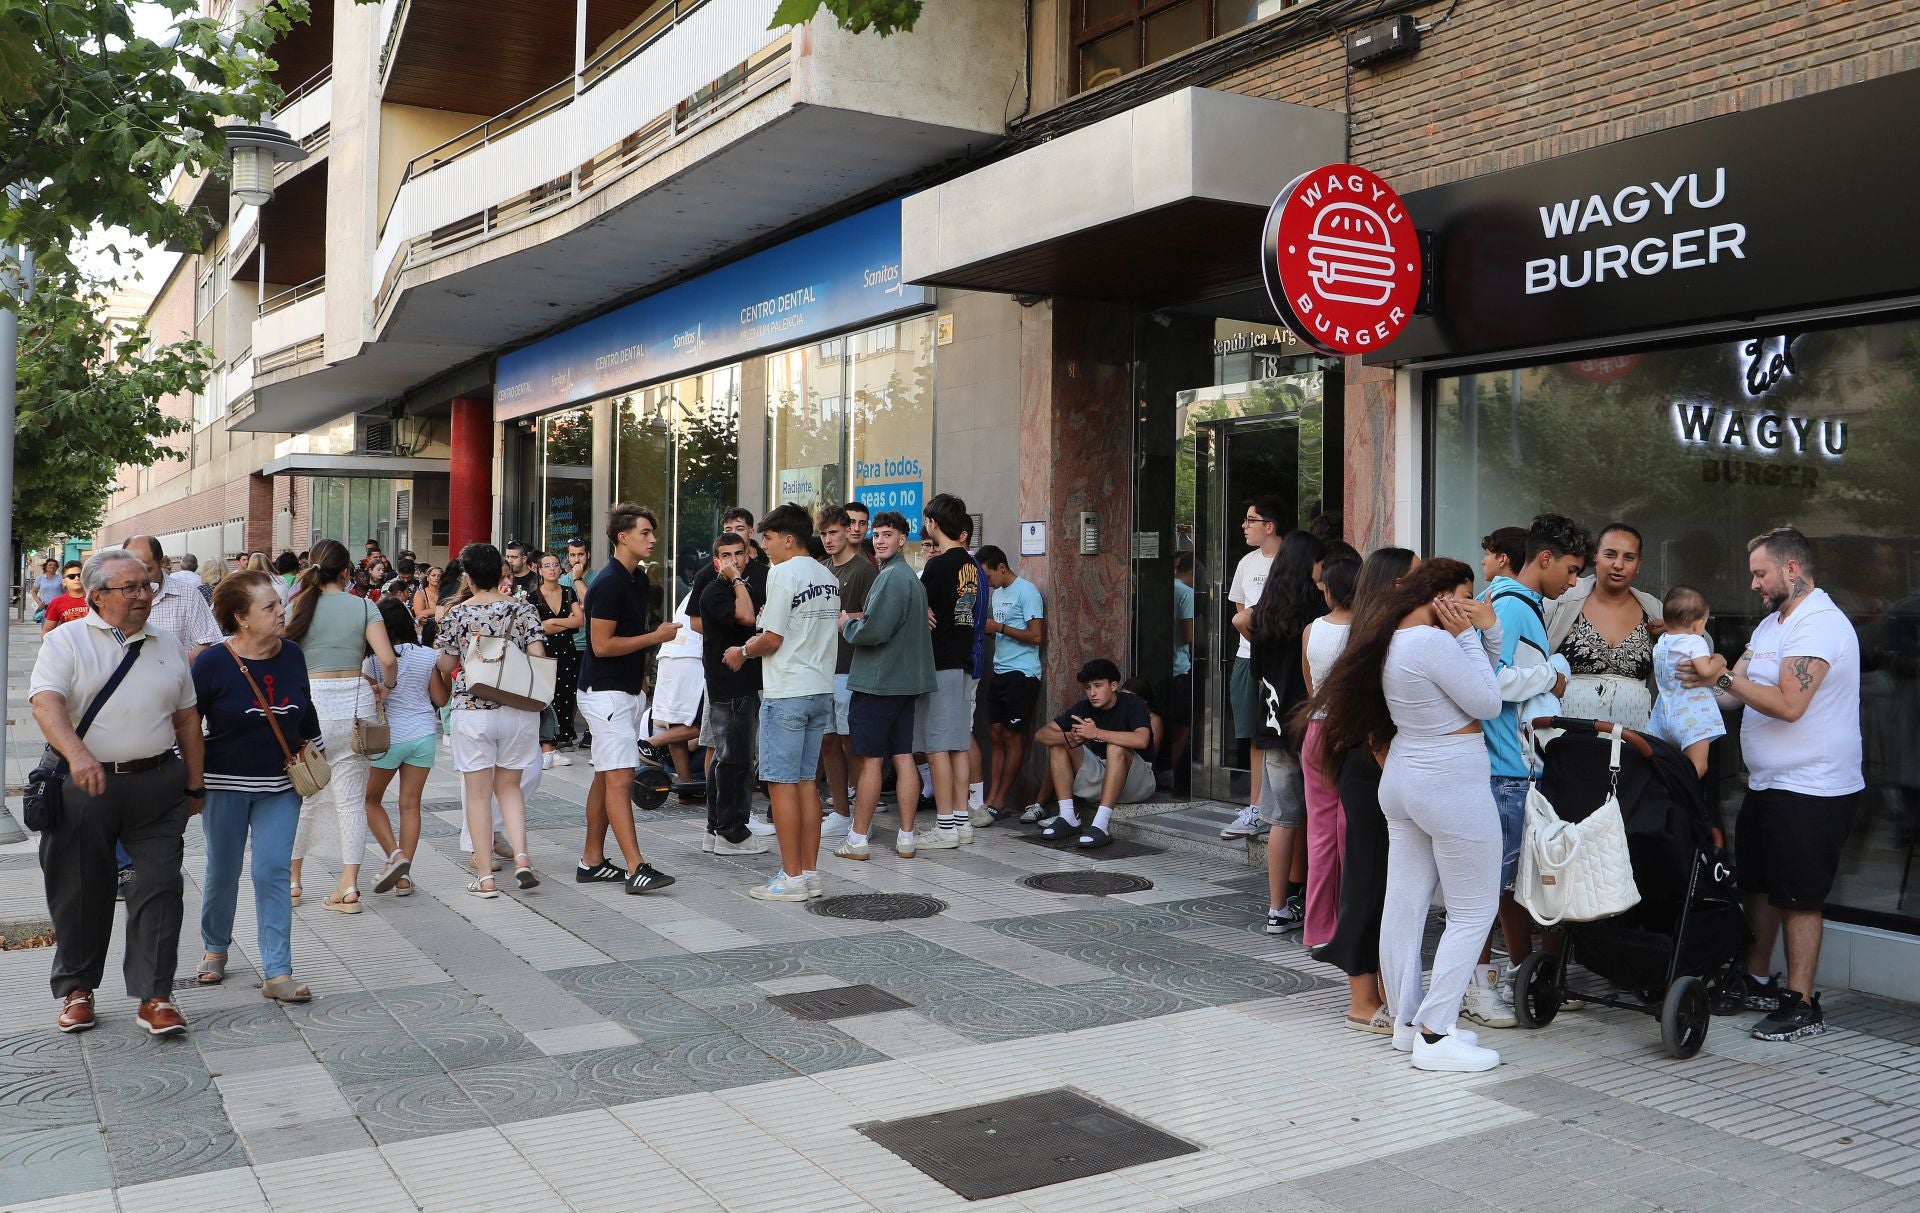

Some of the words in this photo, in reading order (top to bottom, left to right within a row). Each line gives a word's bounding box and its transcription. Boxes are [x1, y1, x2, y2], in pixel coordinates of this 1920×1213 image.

[1300, 174, 1403, 224] WAGYU
[1539, 167, 1726, 239] WAGYU
[1525, 222, 1747, 295] BURGER
[864, 264, 899, 288] Sanitas
[740, 298, 776, 324] CENTRO
[778, 285, 816, 313] DENTAL
[770, 312, 804, 334] PALENCIA
[1296, 292, 1405, 345] BURGER
[673, 331, 696, 349] Sanitas
[596, 351, 619, 370] CENTRO
[620, 343, 645, 363] DENTAL
[1260, 356, 1278, 380] 18
[1677, 403, 1849, 455] WAGYU
[856, 459, 881, 479] Para
[884, 456, 922, 478] todos,
[1702, 460, 1818, 488] BURGER
[782, 481, 814, 494] Radiante.
[861, 492, 886, 507] seas
[889, 491, 896, 506] o
[900, 490, 916, 506] no
[824, 584, 840, 597] STU
